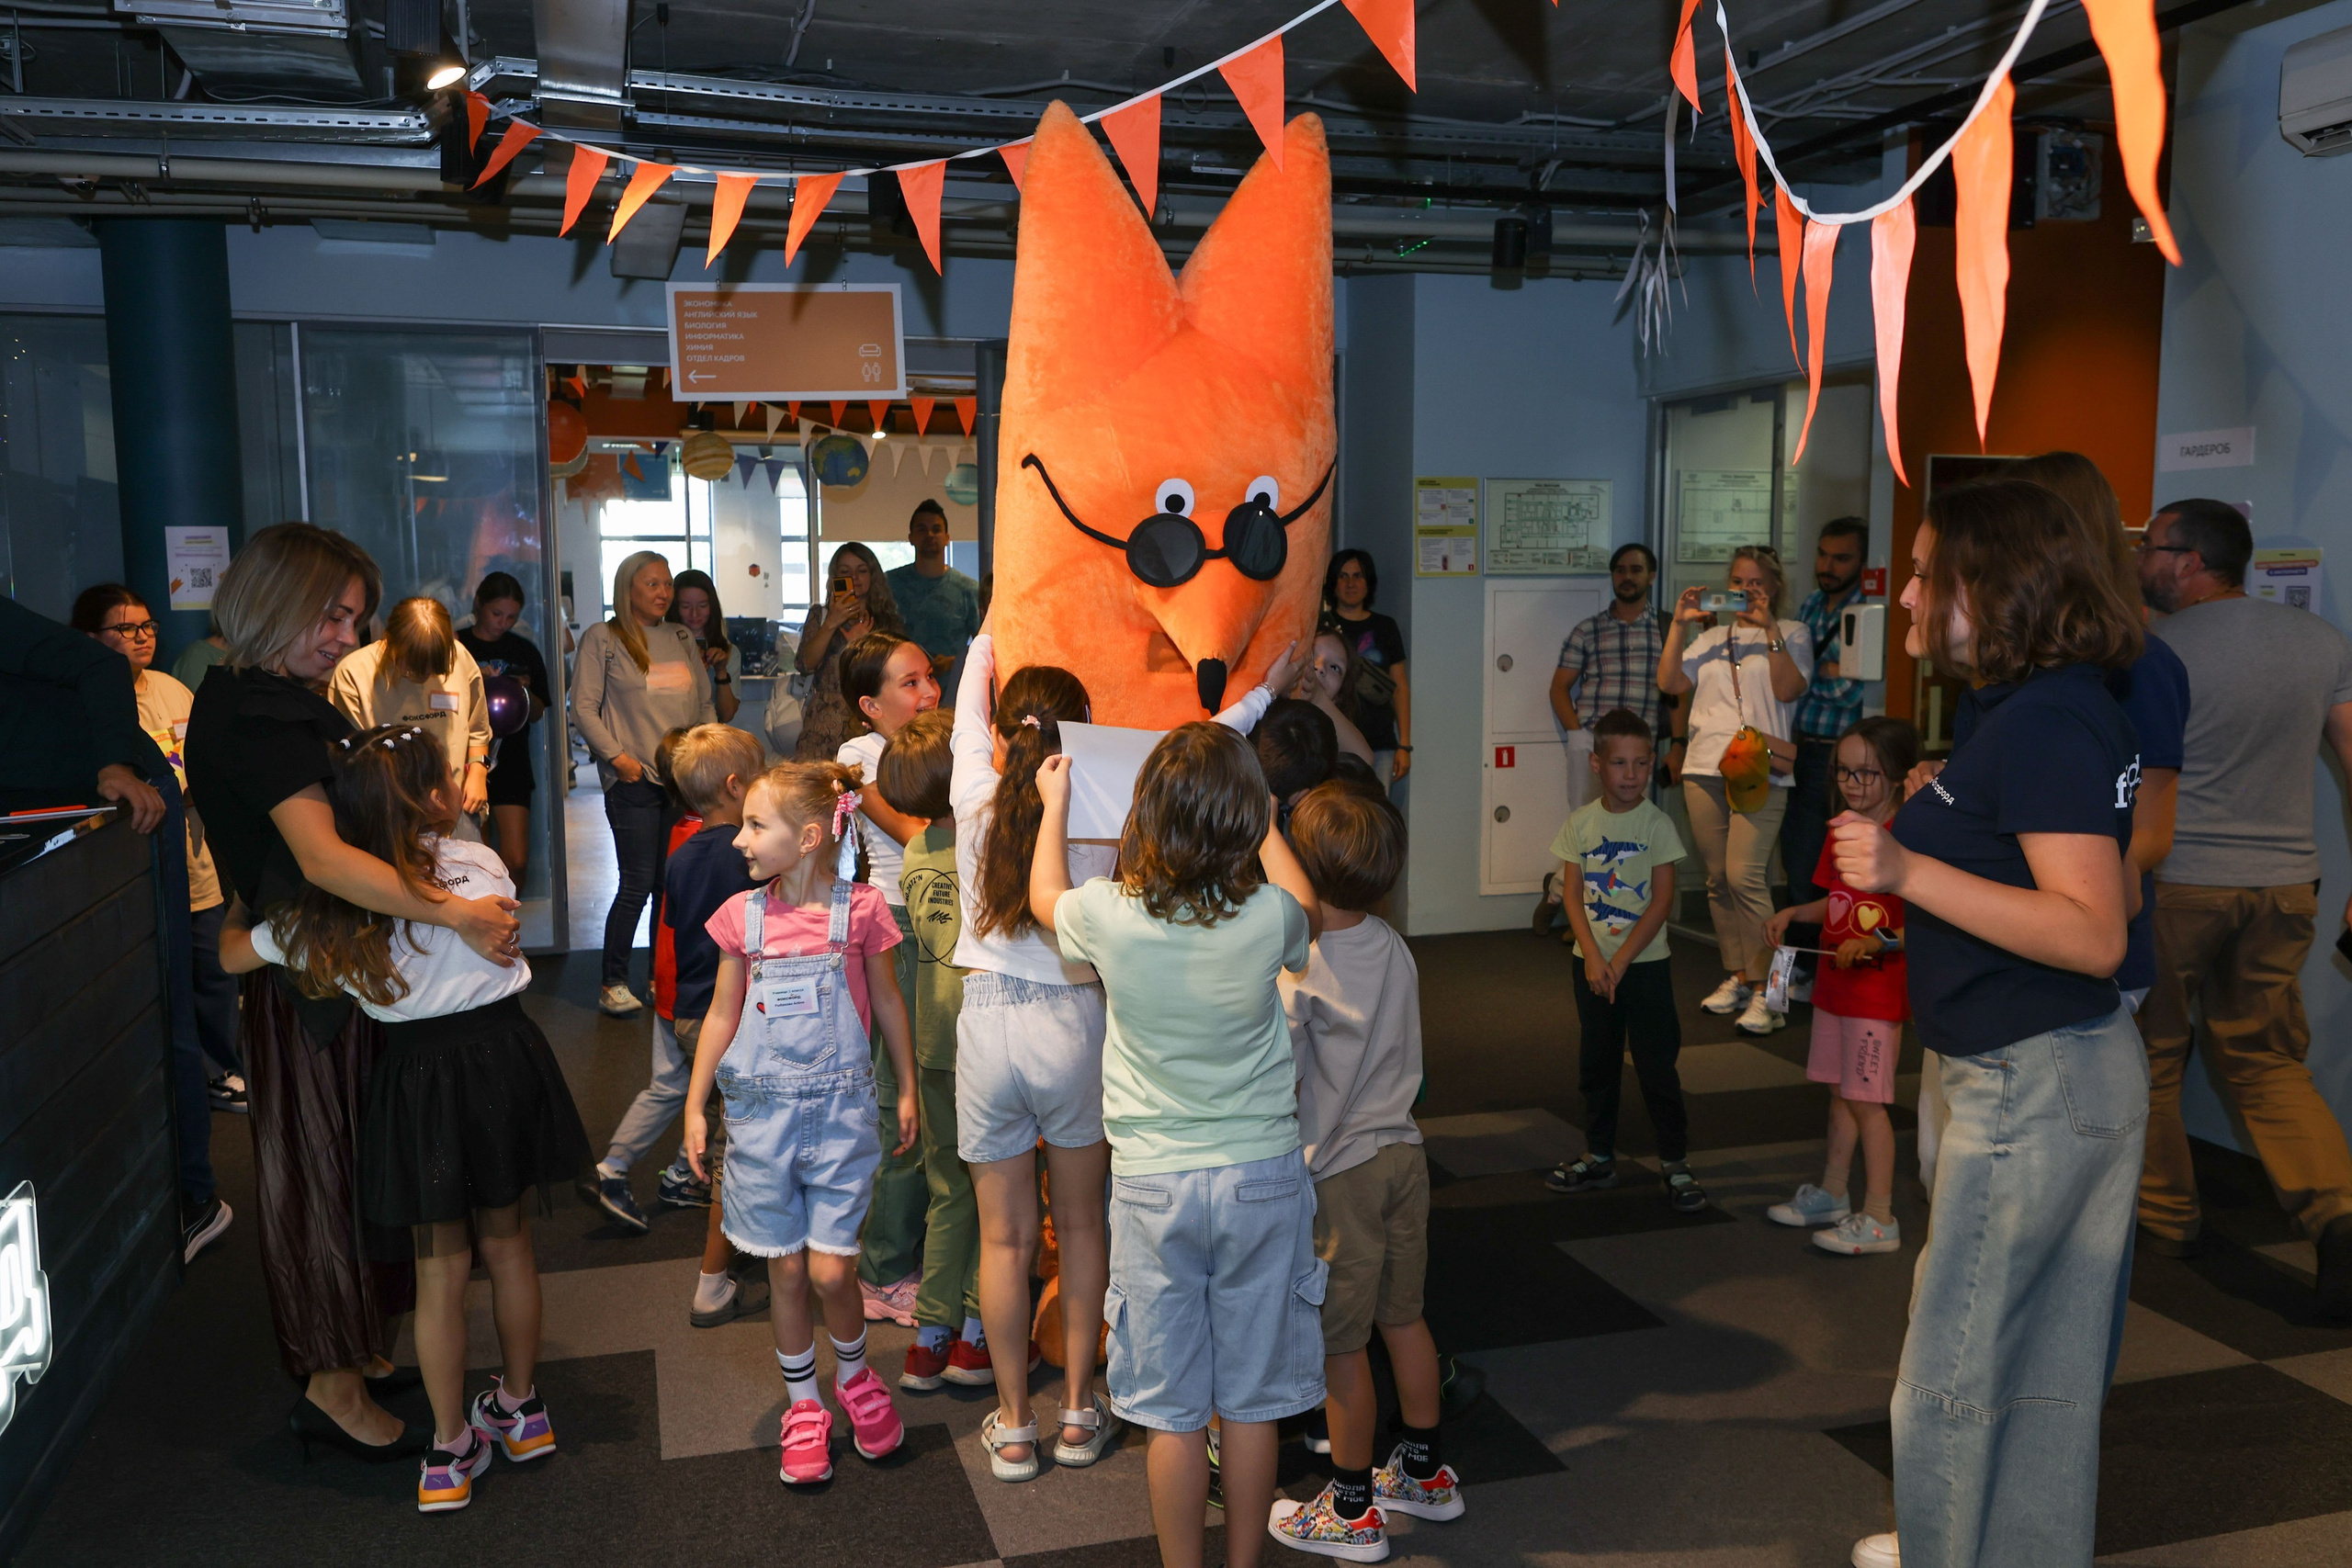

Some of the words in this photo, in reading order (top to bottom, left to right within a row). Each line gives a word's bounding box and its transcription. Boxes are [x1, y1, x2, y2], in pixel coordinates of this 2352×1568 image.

[684, 299, 732, 308] ЭКОНОМА
[686, 355, 713, 363] ОТДЕЛ
[2179, 442, 2232, 457] ГАРДЕРОБ
[932, 882, 953, 891] CREATIVE
[933, 890, 951, 898] FUTURE
[927, 897, 954, 907] INDUSTRIES
